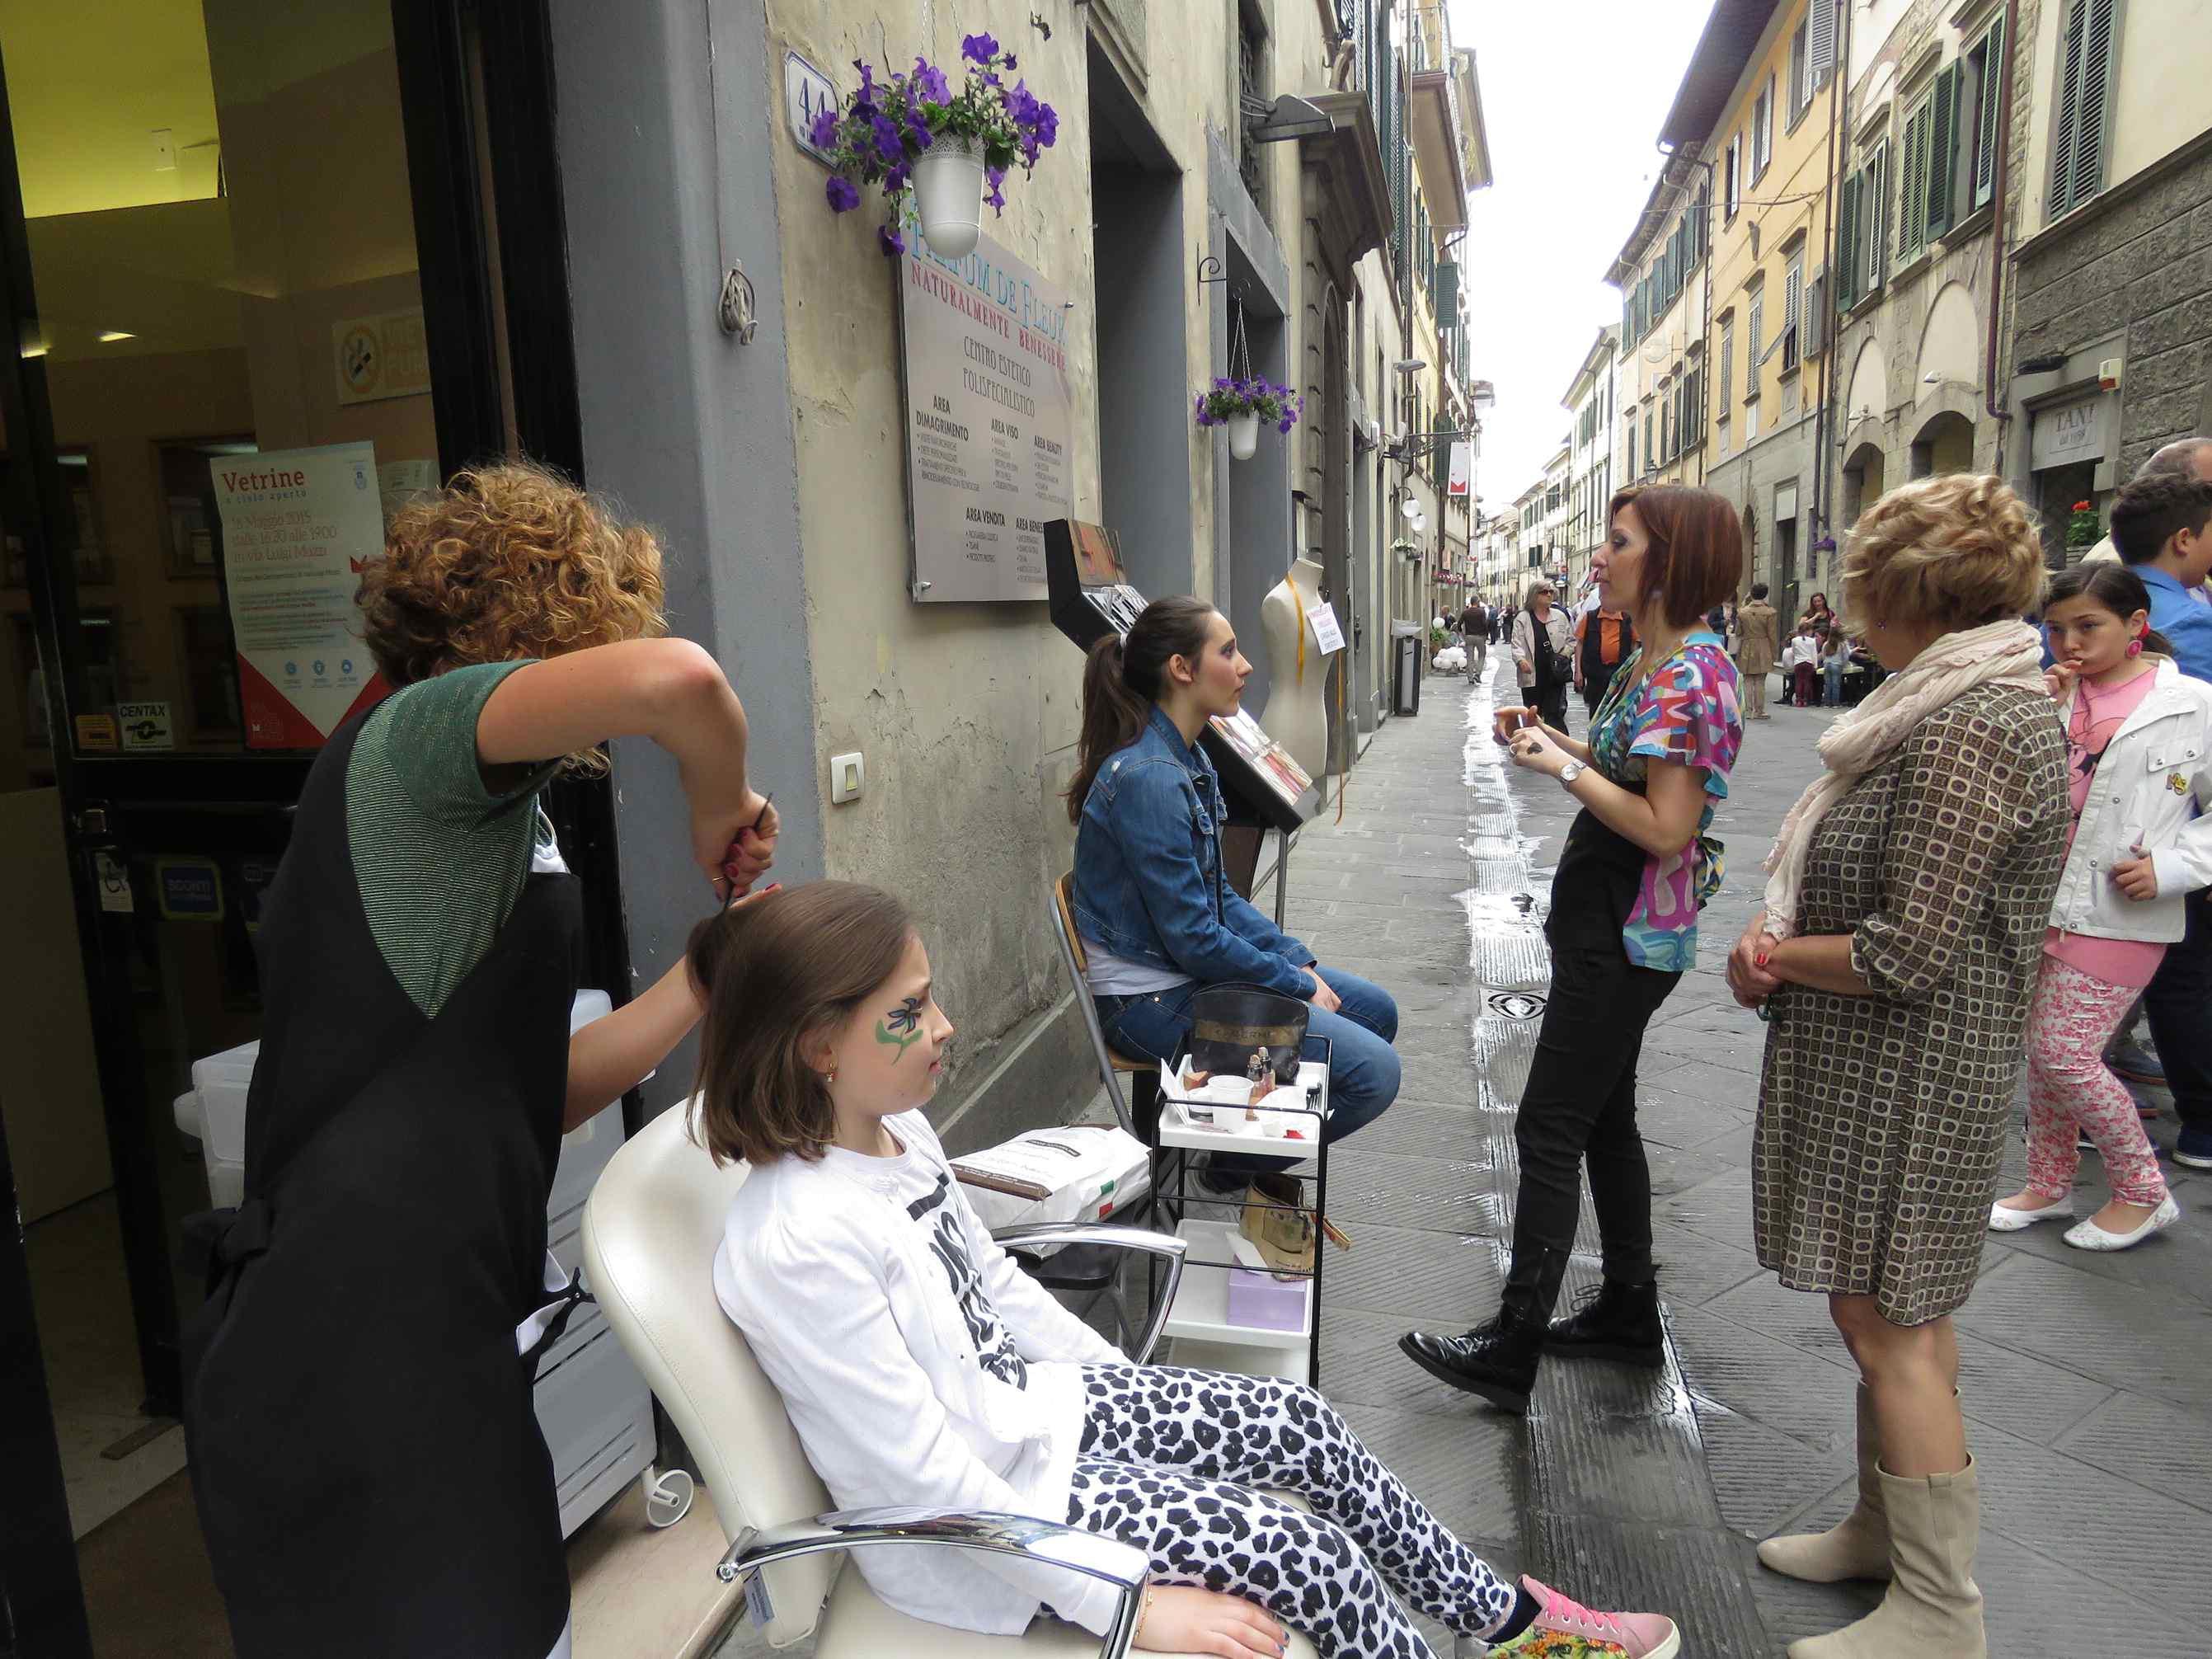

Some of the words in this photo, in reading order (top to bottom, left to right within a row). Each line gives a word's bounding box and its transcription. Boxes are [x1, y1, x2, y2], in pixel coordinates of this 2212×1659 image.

[996, 269, 1017, 313] DE
[910, 261, 1010, 339] NATURALMENTE
[1018, 328, 1066, 370] BENESSERE
[964, 336, 996, 369] CENTRO
[998, 354, 1031, 388] ESTETICO
[963, 367, 1036, 417] POLISPECIALISTICO
[933, 395, 951, 415] AREA
[916, 411, 970, 442] DIMAGRIMENTO
[991, 418, 1005, 435] AREA
[1006, 423, 1019, 440] VISO
[1034, 435, 1045, 449] AREA
[1046, 439, 1062, 456] BEAUTY
[223, 468, 305, 493] Vetrine
[965, 507, 982, 523] AREA
[982, 510, 1005, 527] VENDITA
[1016, 517, 1028, 531] AREA
[120, 705, 166, 717] CENTAX
